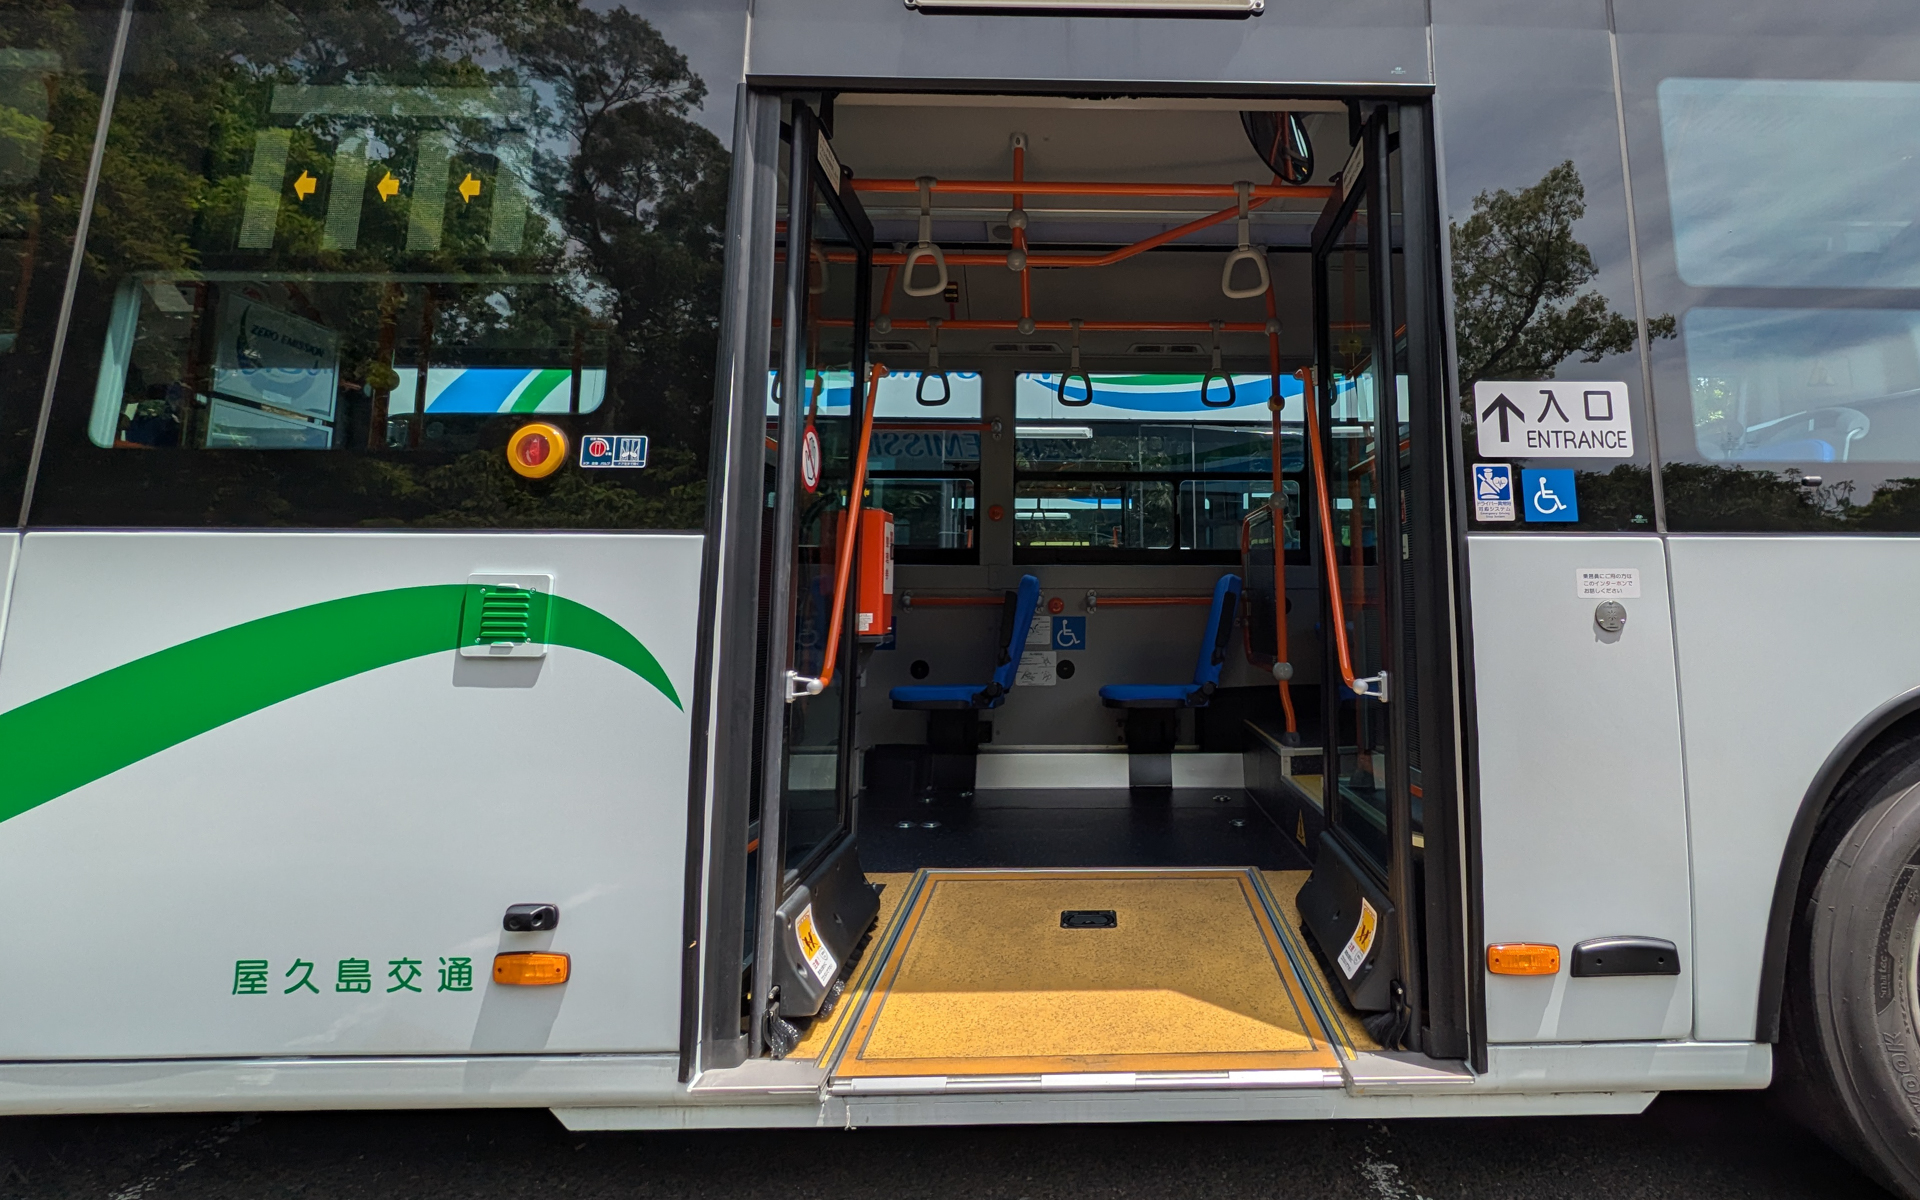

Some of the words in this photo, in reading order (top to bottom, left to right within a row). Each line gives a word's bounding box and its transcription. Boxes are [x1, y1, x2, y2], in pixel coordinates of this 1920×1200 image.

[250, 324, 279, 342] ZERO
[280, 334, 326, 358] EMISSION
[1537, 389, 1614, 423] 入口
[1526, 430, 1628, 449] ENTRANCE
[232, 957, 474, 995] 屋久島交通
[1878, 955, 1888, 999] Smartec
